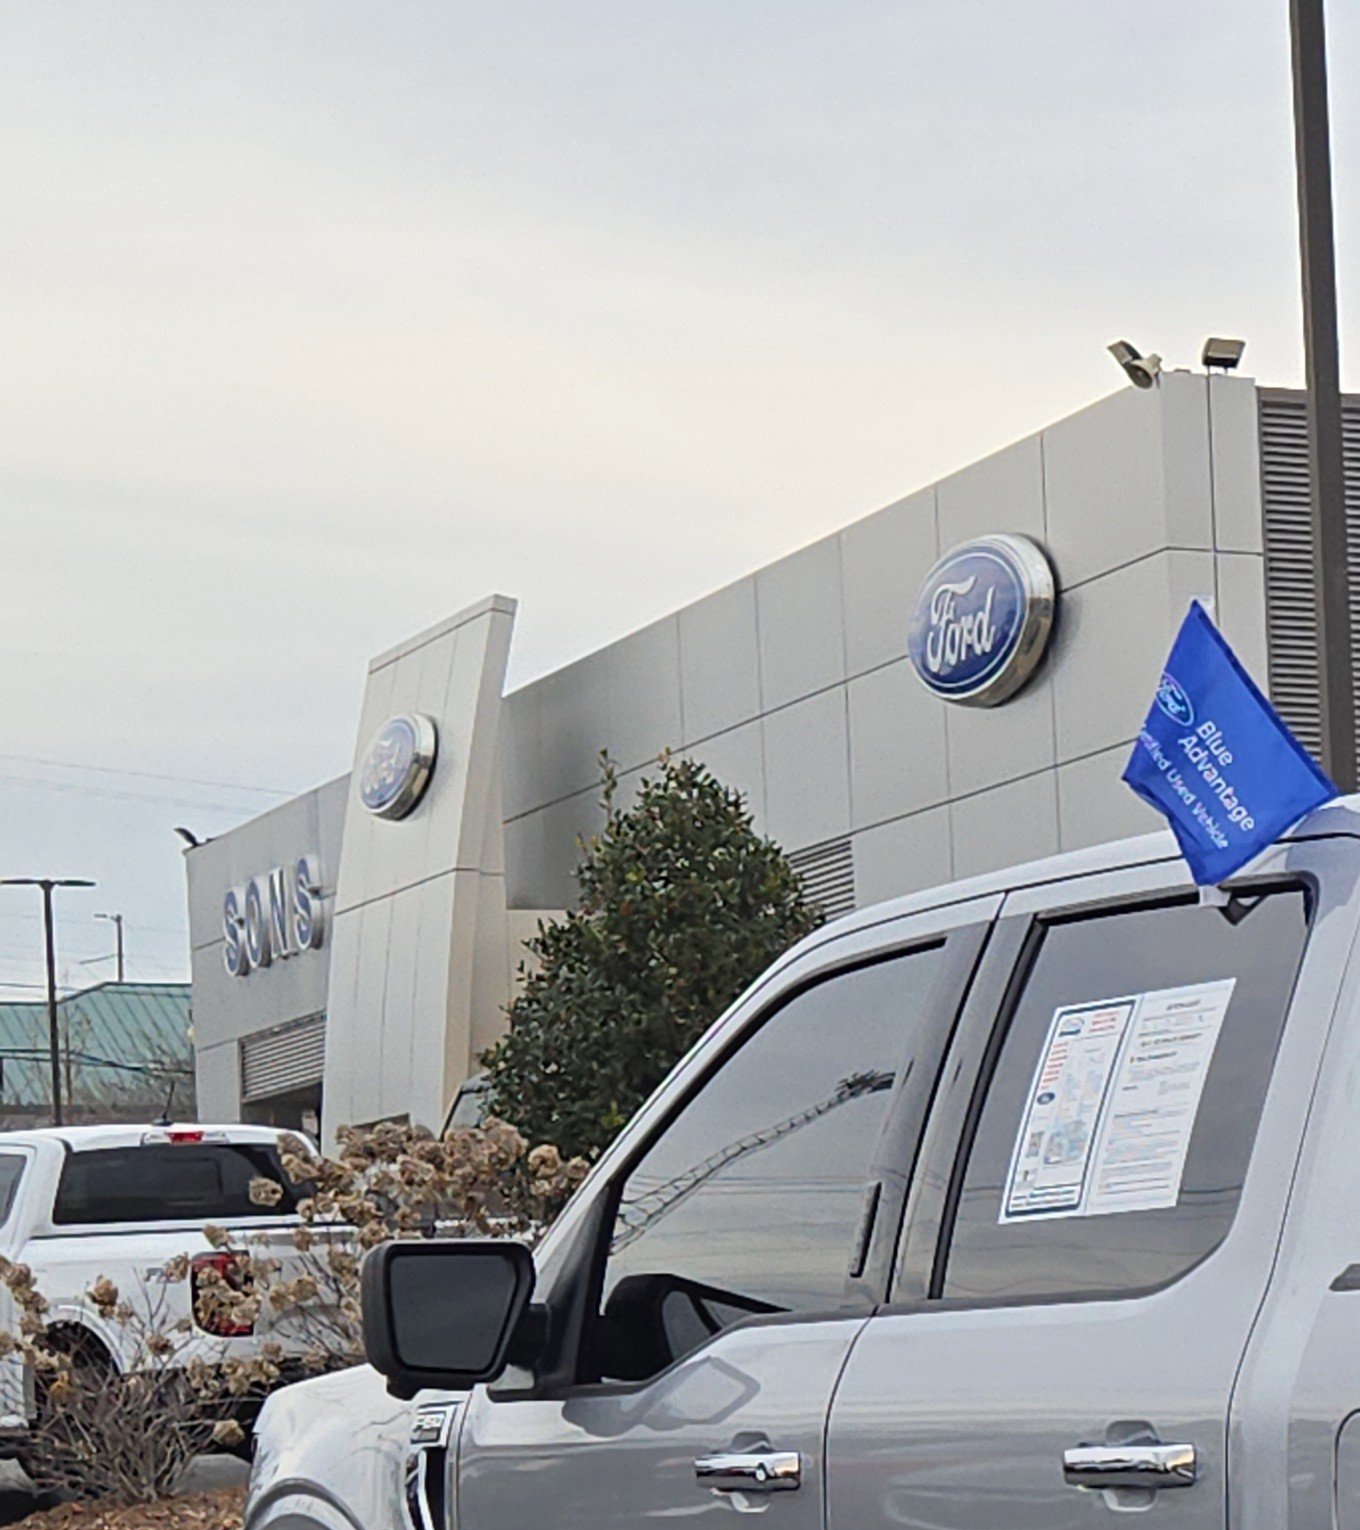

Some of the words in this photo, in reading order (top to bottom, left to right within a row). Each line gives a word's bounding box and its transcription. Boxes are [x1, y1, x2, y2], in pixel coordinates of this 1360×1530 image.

[927, 574, 996, 673] Ford
[1177, 734, 1255, 832] Advantage
[1195, 720, 1233, 766] Blue
[1165, 767, 1197, 806] Used
[1191, 801, 1229, 849] Vehicle
[223, 857, 322, 976] SONS
